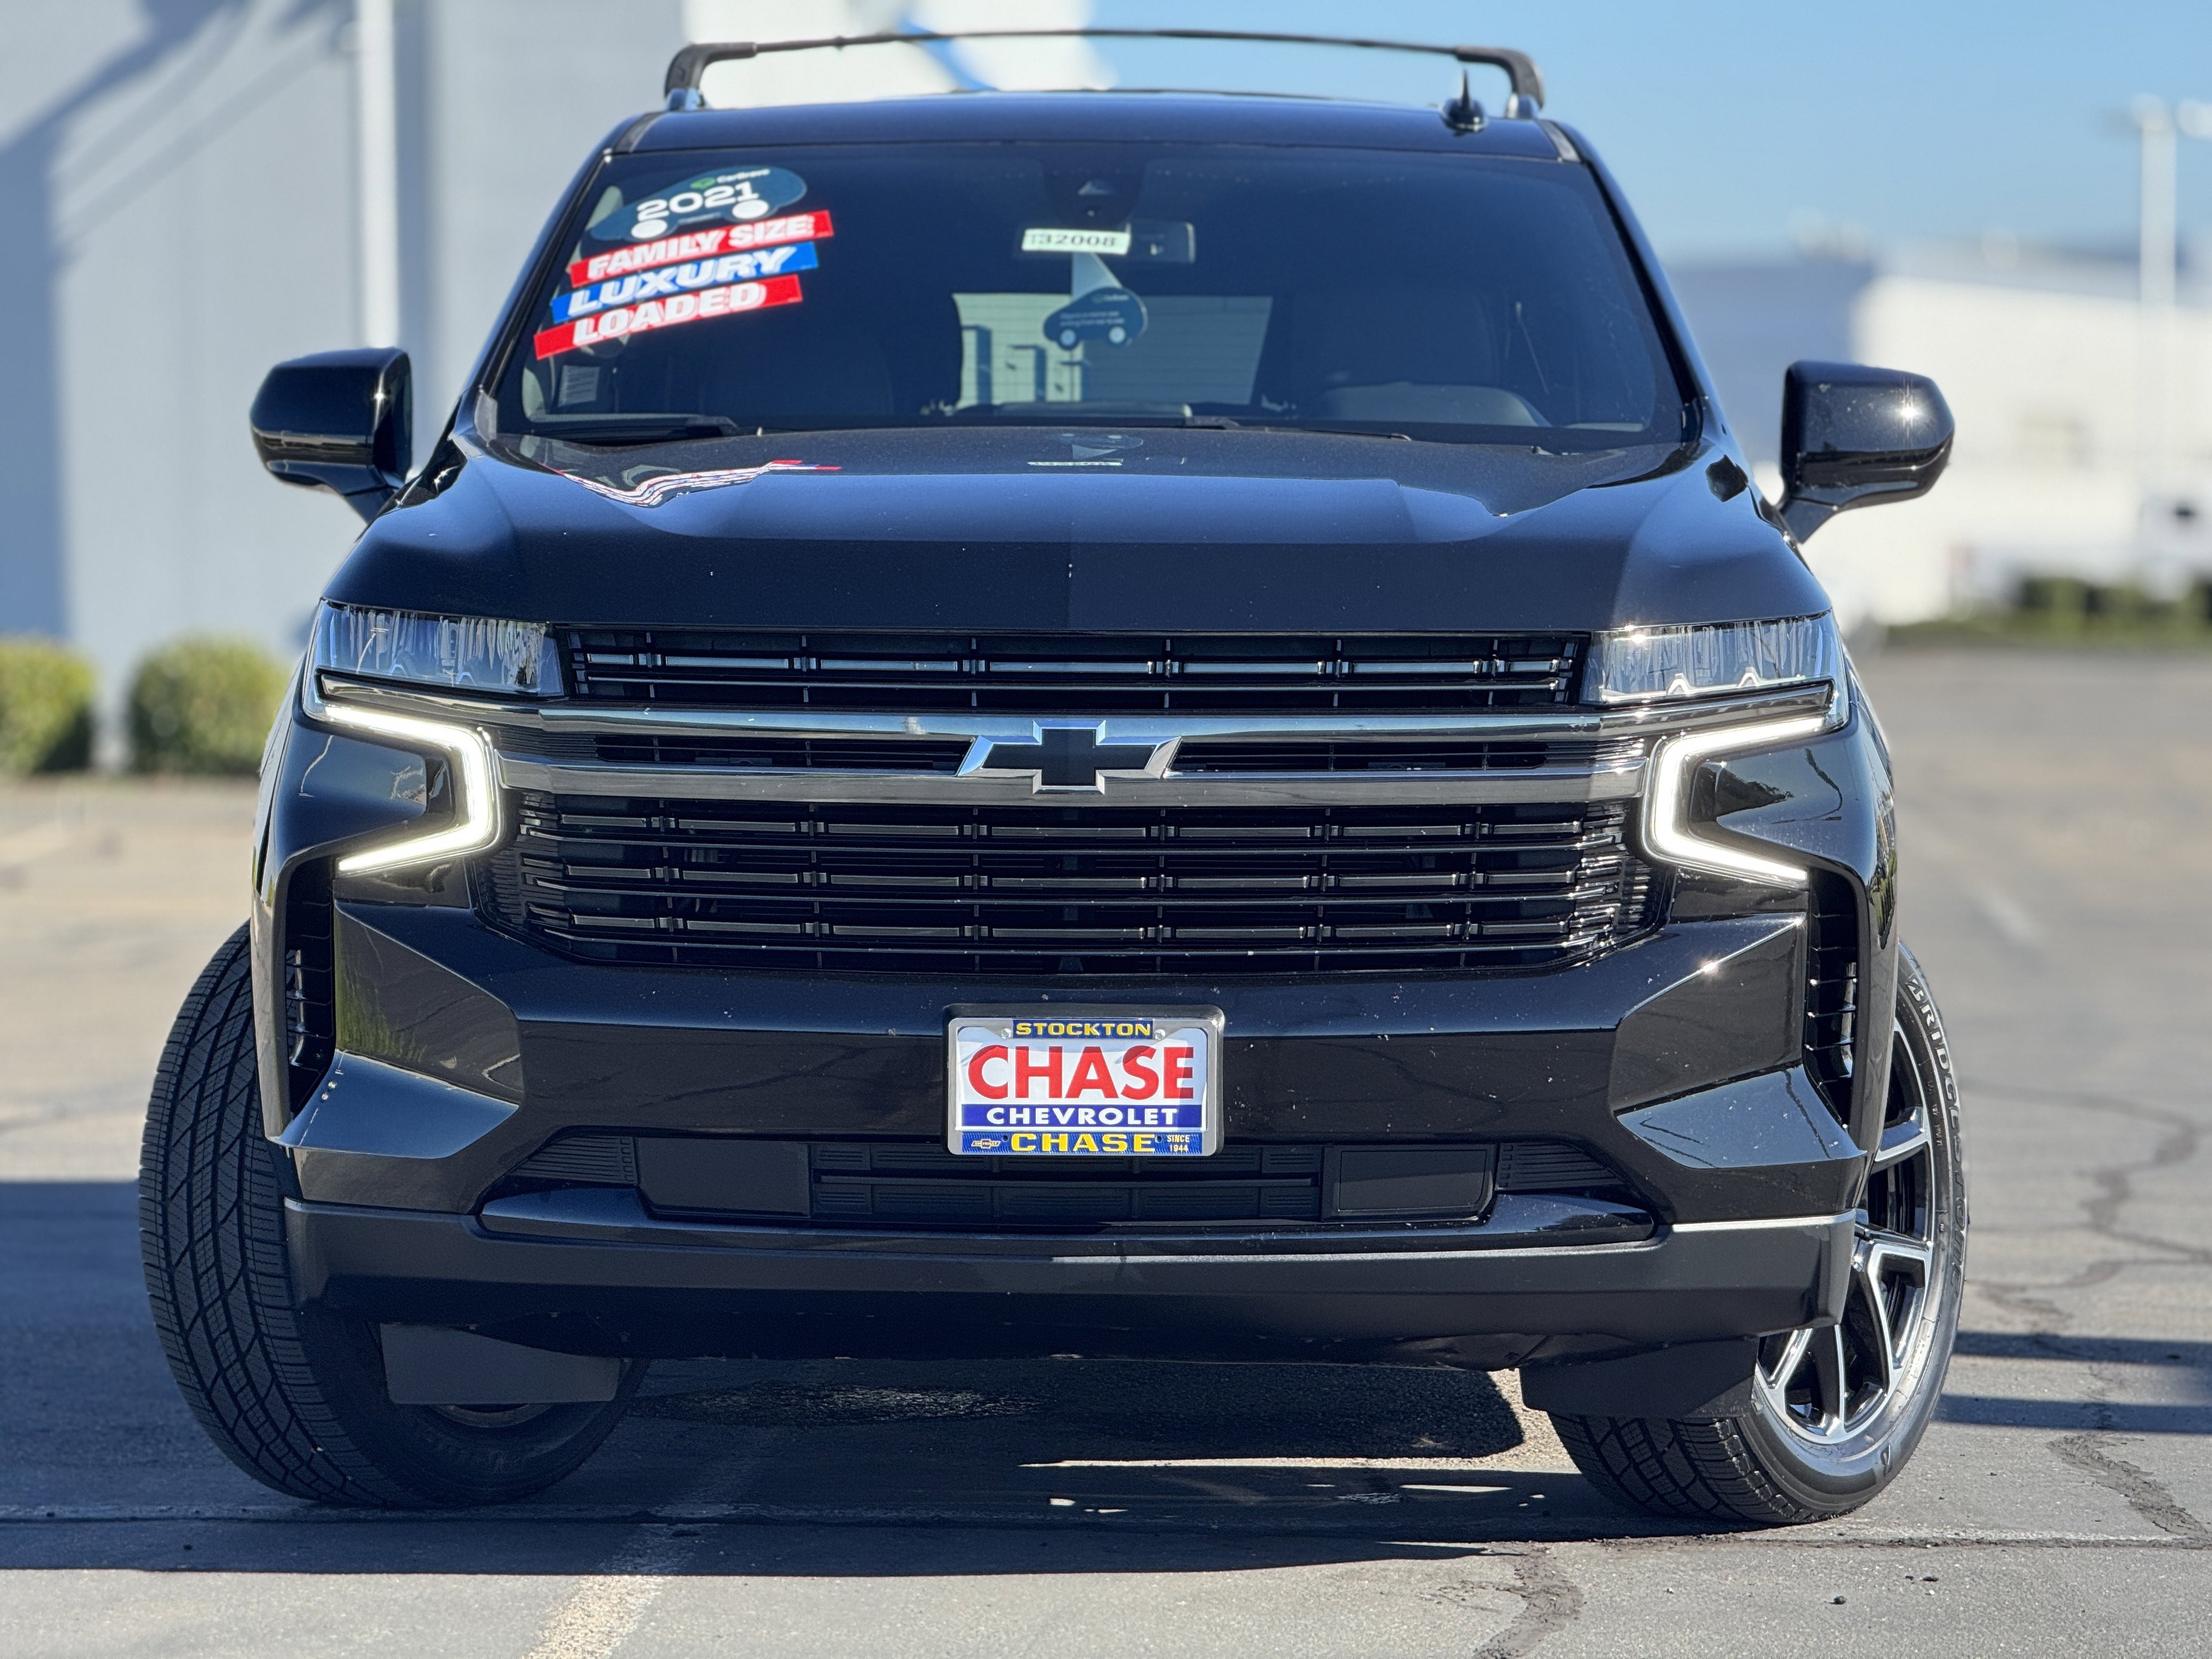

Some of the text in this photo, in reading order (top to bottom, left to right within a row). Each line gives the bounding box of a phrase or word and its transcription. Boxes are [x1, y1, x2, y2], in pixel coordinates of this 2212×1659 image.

[636, 182, 759, 222] 2021
[587, 215, 814, 279] FAMILY SIZE
[568, 246, 797, 315] LUXURY
[573, 283, 766, 346] LOADED
[1015, 1023, 1150, 1036] STOCKTON
[968, 1045, 1194, 1100] CHASE
[987, 1107, 1177, 1125] CHEVROLET
[1011, 1133, 1155, 1152] CHASE
[1167, 1135, 1190, 1143] SINCE
[1170, 1144, 1189, 1153] 1944
